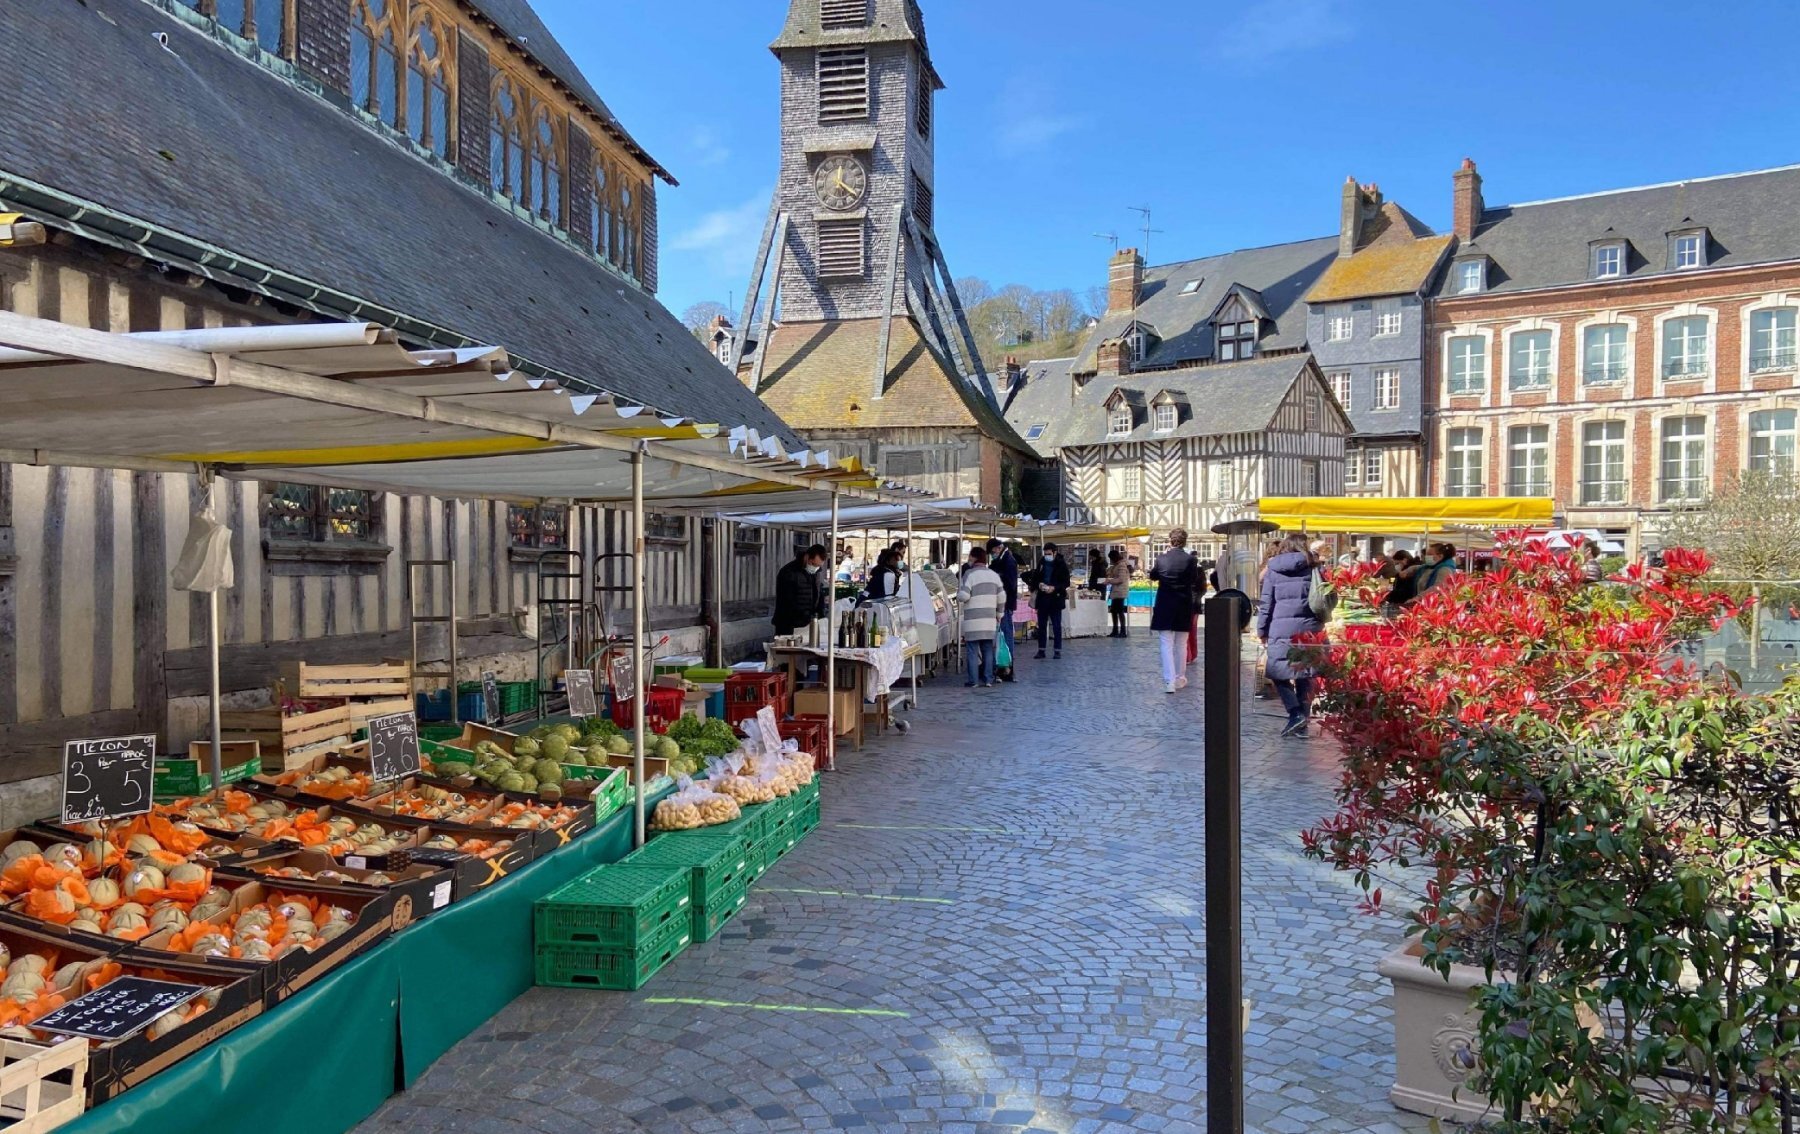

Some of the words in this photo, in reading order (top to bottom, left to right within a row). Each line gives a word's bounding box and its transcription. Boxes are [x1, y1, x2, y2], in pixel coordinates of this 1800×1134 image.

[375, 716, 404, 728] MELON
[76, 739, 131, 754] MELON
[374, 733, 387, 758] 3
[66, 761, 92, 794] 3
[42, 1009, 70, 1025] NE
[73, 990, 111, 1007] PAS
[64, 989, 138, 1024] TOUCHER
[76, 1018, 105, 1031] NE
[103, 999, 137, 1014] PAS
